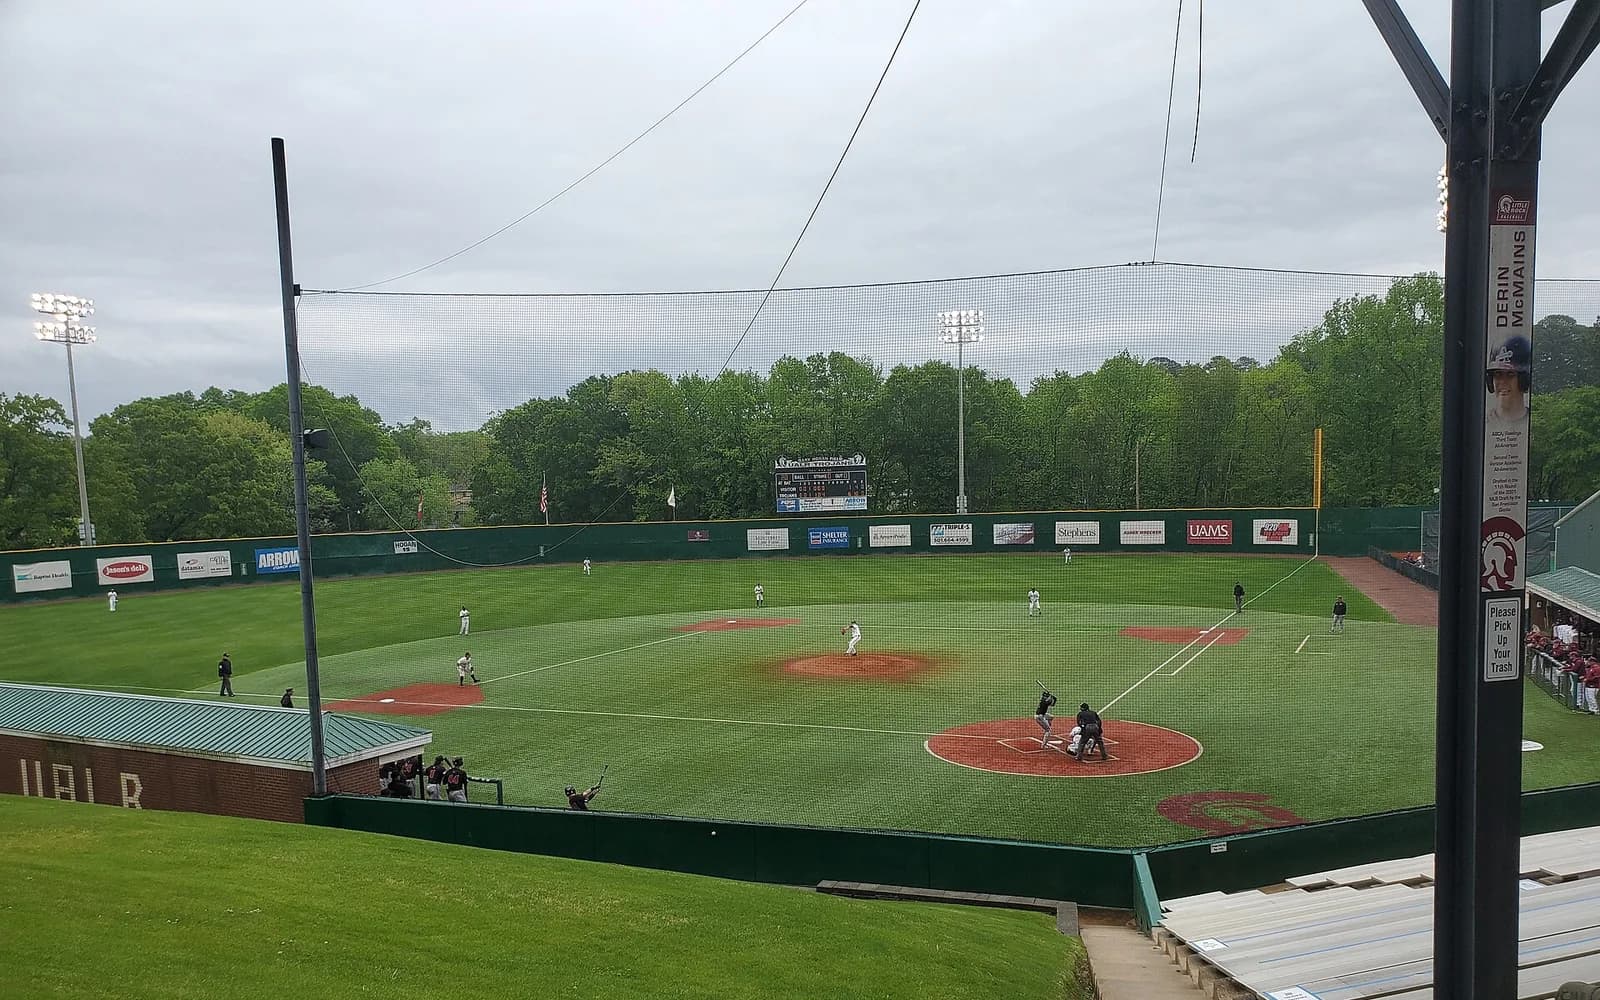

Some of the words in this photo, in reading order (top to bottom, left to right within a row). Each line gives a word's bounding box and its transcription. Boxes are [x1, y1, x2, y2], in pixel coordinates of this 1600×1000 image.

[1512, 231, 1525, 327] McMAINS
[1496, 267, 1509, 327] DERIN
[1058, 527, 1096, 538] Stephens
[1190, 524, 1228, 537] UAMS
[106, 567, 130, 575] Jason's
[1490, 607, 1516, 618] Please
[1494, 620, 1512, 632] Pick
[1497, 635, 1508, 647] Up
[1494, 648, 1511, 659] Your
[1491, 662, 1512, 673] Trash
